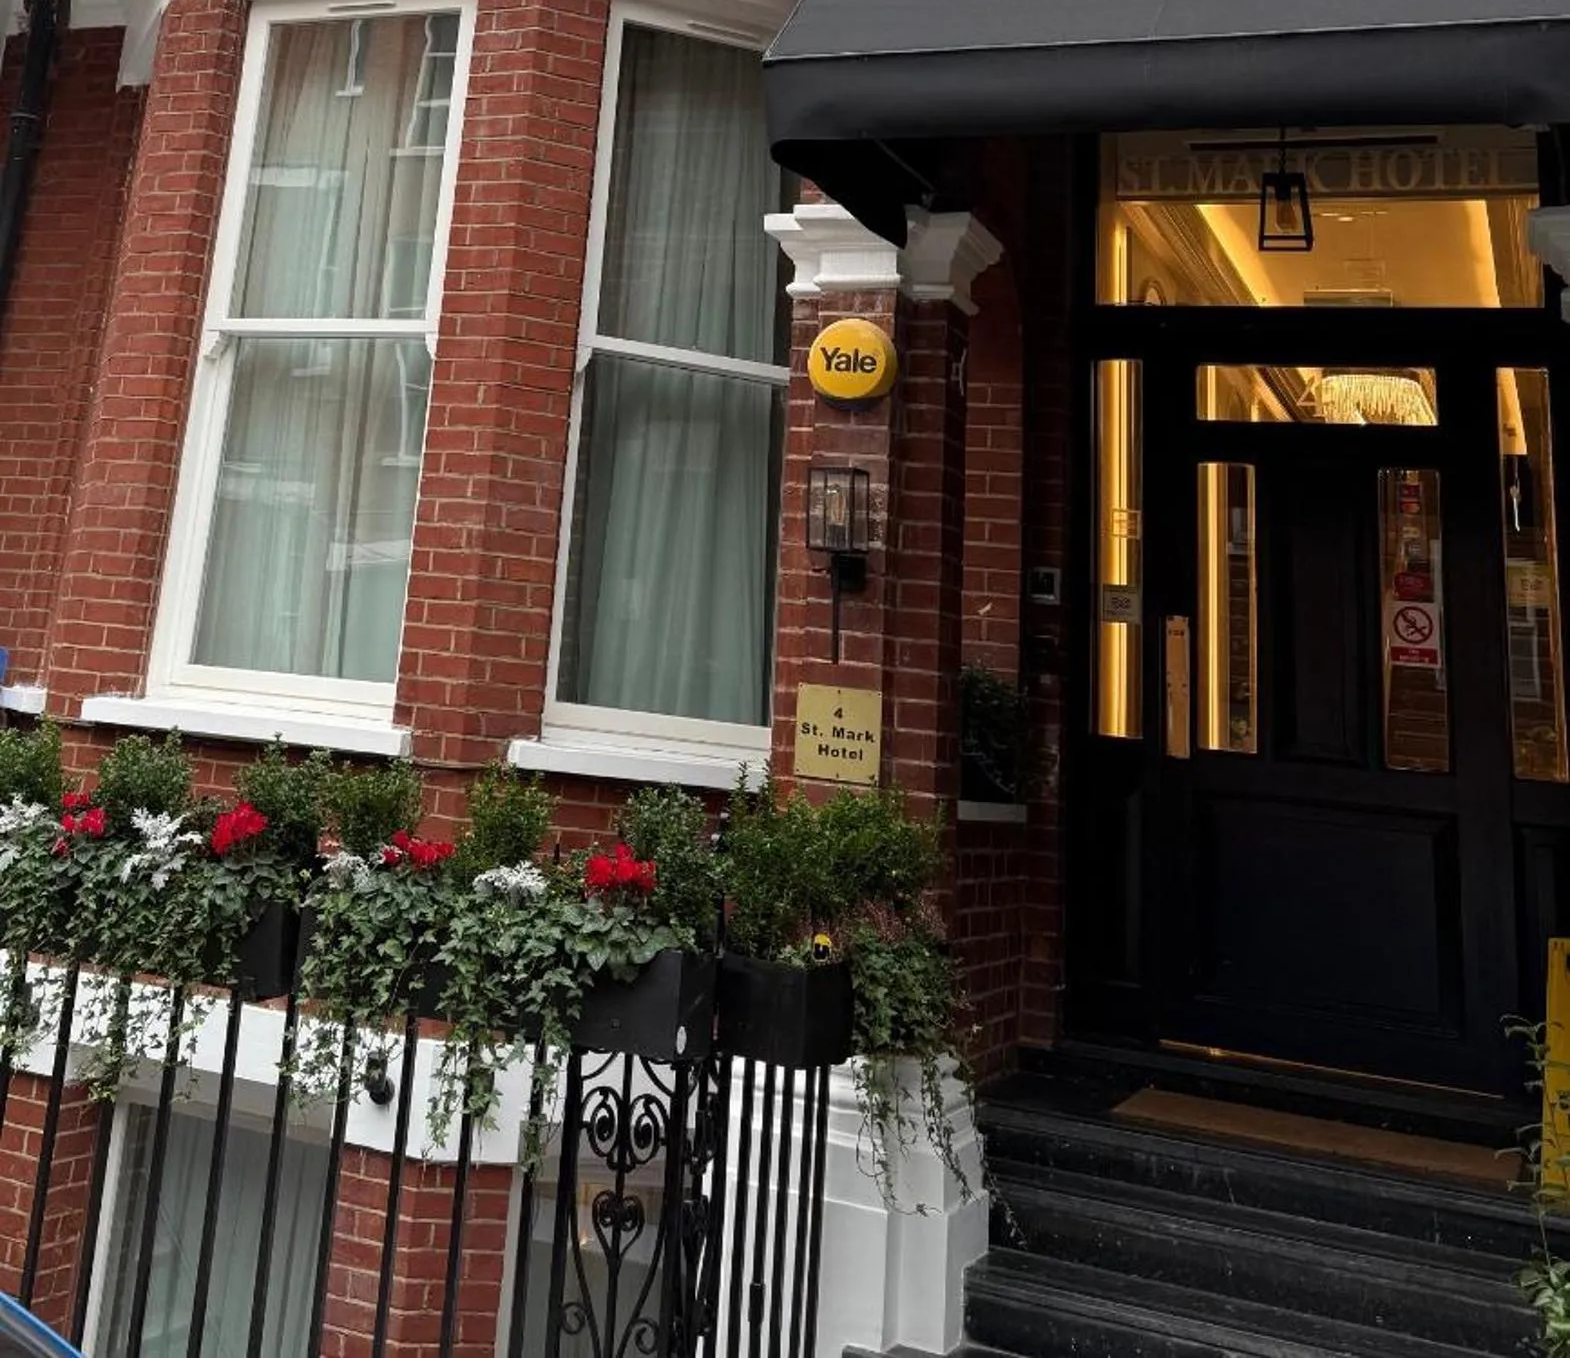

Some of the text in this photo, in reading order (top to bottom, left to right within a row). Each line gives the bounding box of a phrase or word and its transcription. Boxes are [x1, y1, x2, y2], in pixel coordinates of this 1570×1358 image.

[820, 347, 877, 374] Yale
[833, 707, 843, 719] 4
[800, 722, 876, 743] St. Mark
[817, 744, 863, 761] Hotel
